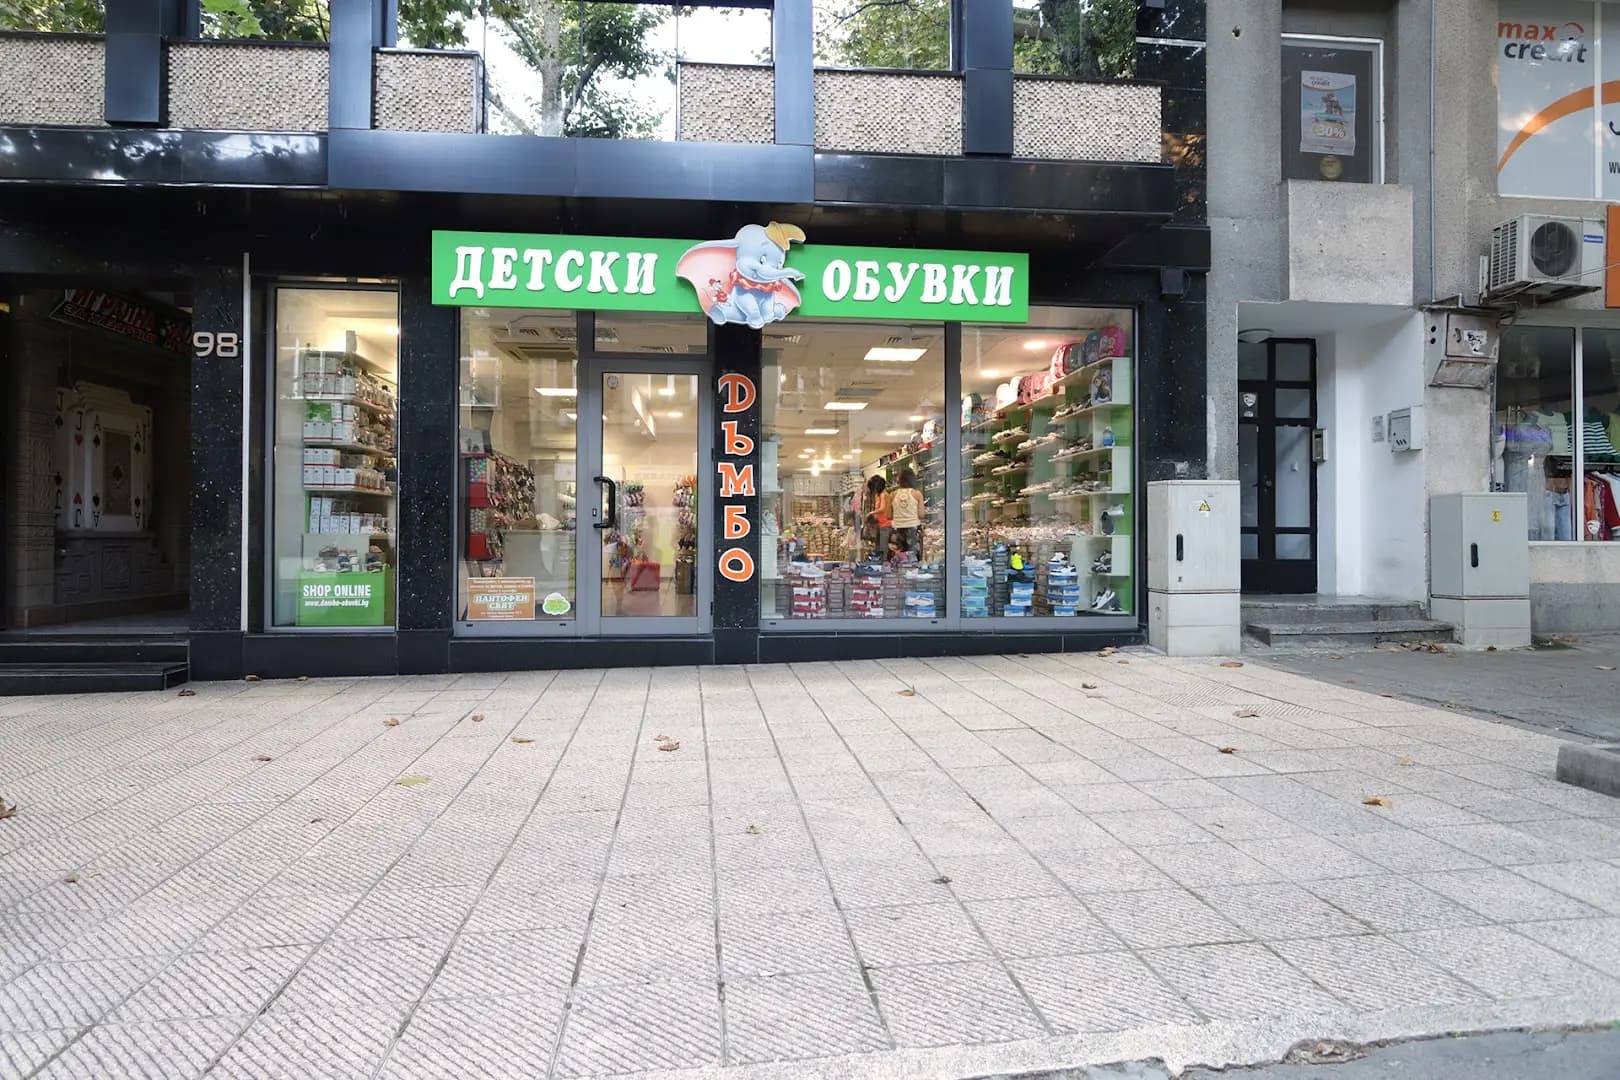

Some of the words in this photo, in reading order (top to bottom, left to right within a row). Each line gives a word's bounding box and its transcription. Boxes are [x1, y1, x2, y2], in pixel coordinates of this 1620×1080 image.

[1498, 22, 1557, 40] max
[449, 246, 659, 299] ДЕТСКИ
[822, 259, 1015, 306] ОБУВКИ
[193, 331, 238, 357] 98
[303, 585, 331, 597] SHOP
[334, 585, 371, 597] ONLINE
